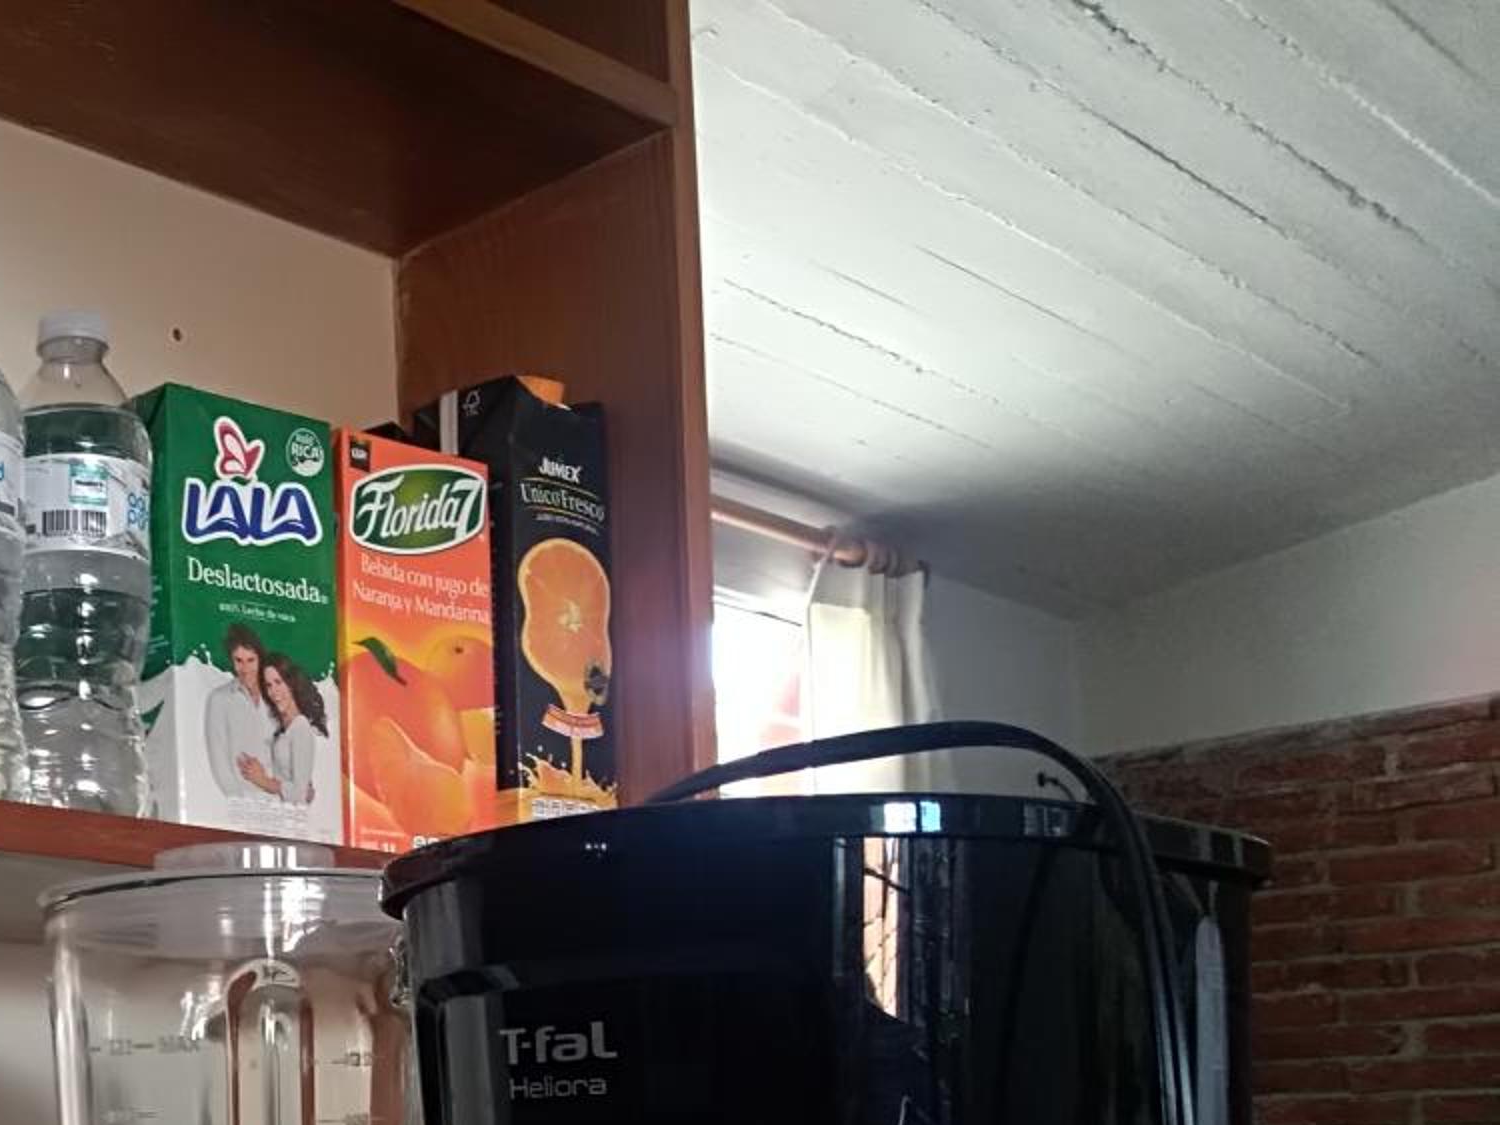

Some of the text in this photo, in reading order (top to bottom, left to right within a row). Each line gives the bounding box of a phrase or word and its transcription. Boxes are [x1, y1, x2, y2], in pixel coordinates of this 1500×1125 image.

[538, 456, 583, 484] JUMEX
[184, 478, 322, 545] LALA
[187, 554, 322, 604] Deslactosada
[361, 552, 489, 601] Bebida con jugo de
[509, 1076, 608, 1100] Heliora
